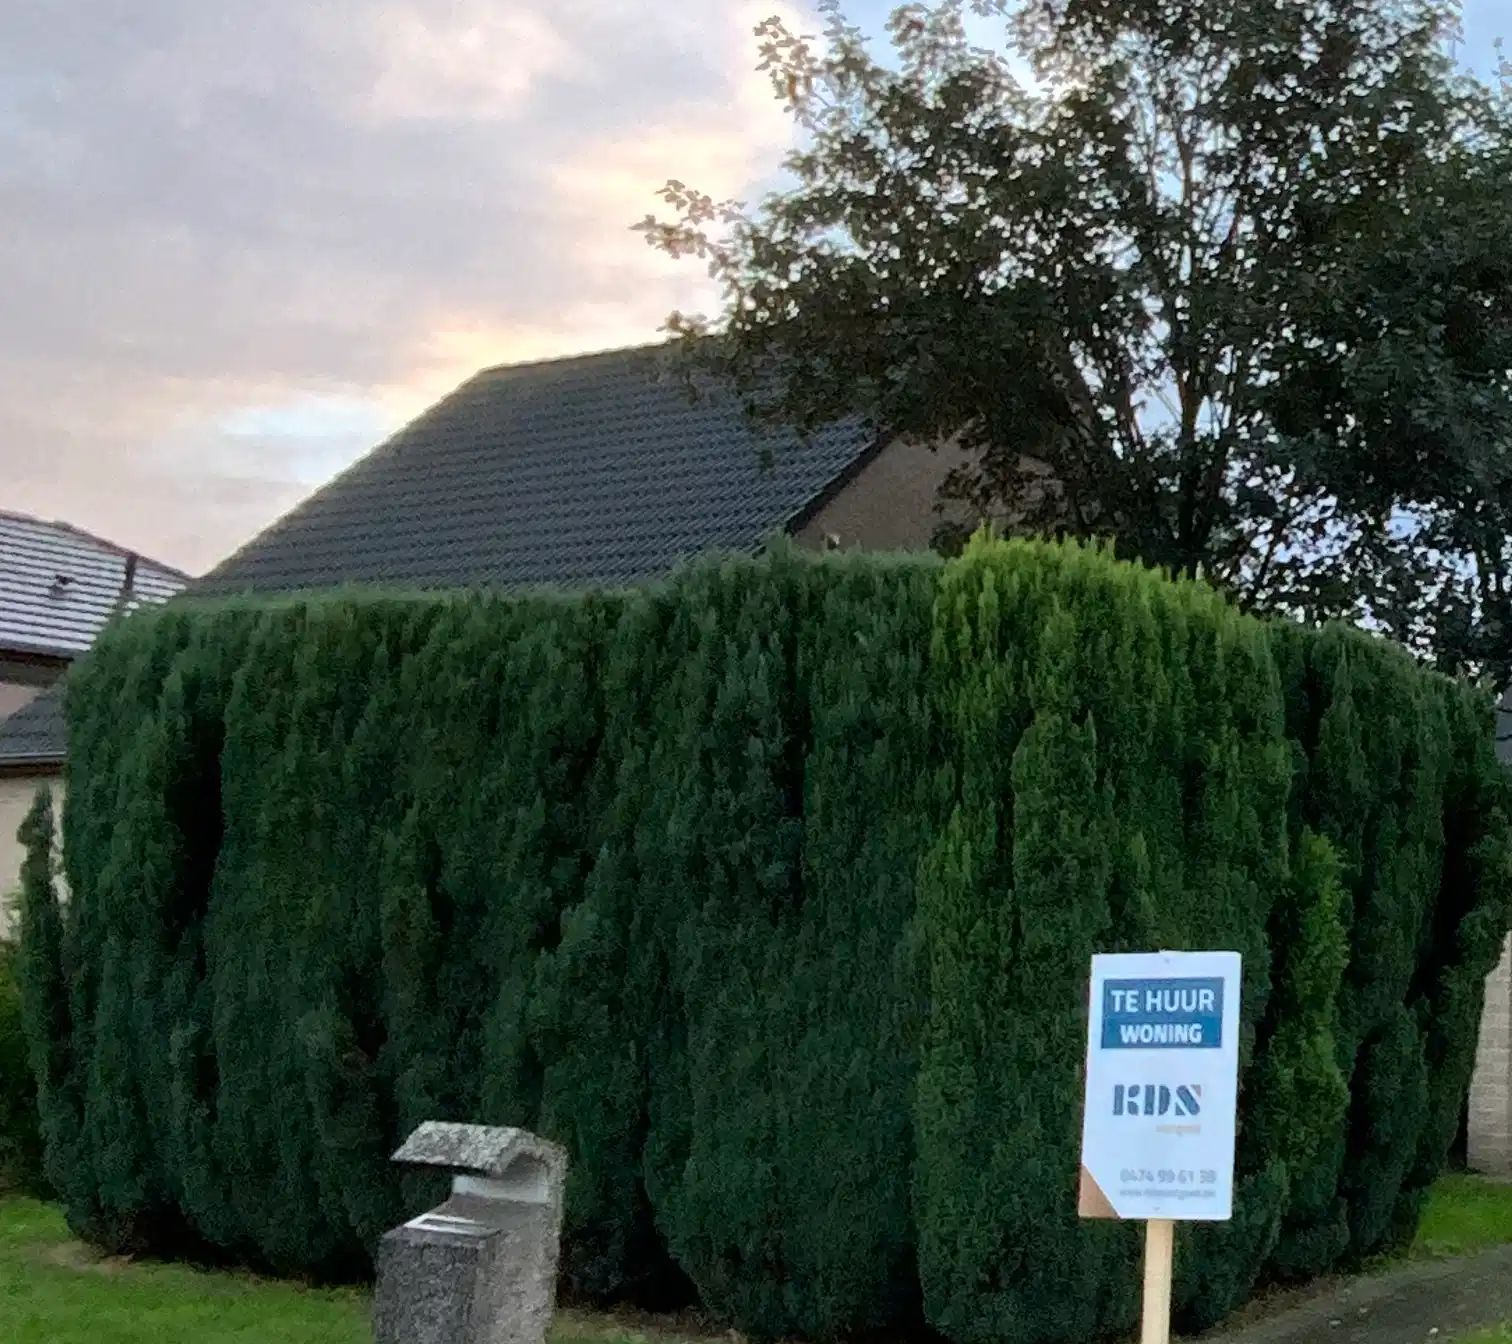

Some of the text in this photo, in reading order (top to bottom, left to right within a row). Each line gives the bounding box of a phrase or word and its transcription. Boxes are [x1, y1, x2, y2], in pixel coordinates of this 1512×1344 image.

[1110, 988, 1215, 1013] TE HUUR
[1120, 1023, 1203, 1045] WONING
[1112, 1083, 1202, 1116] KDS
